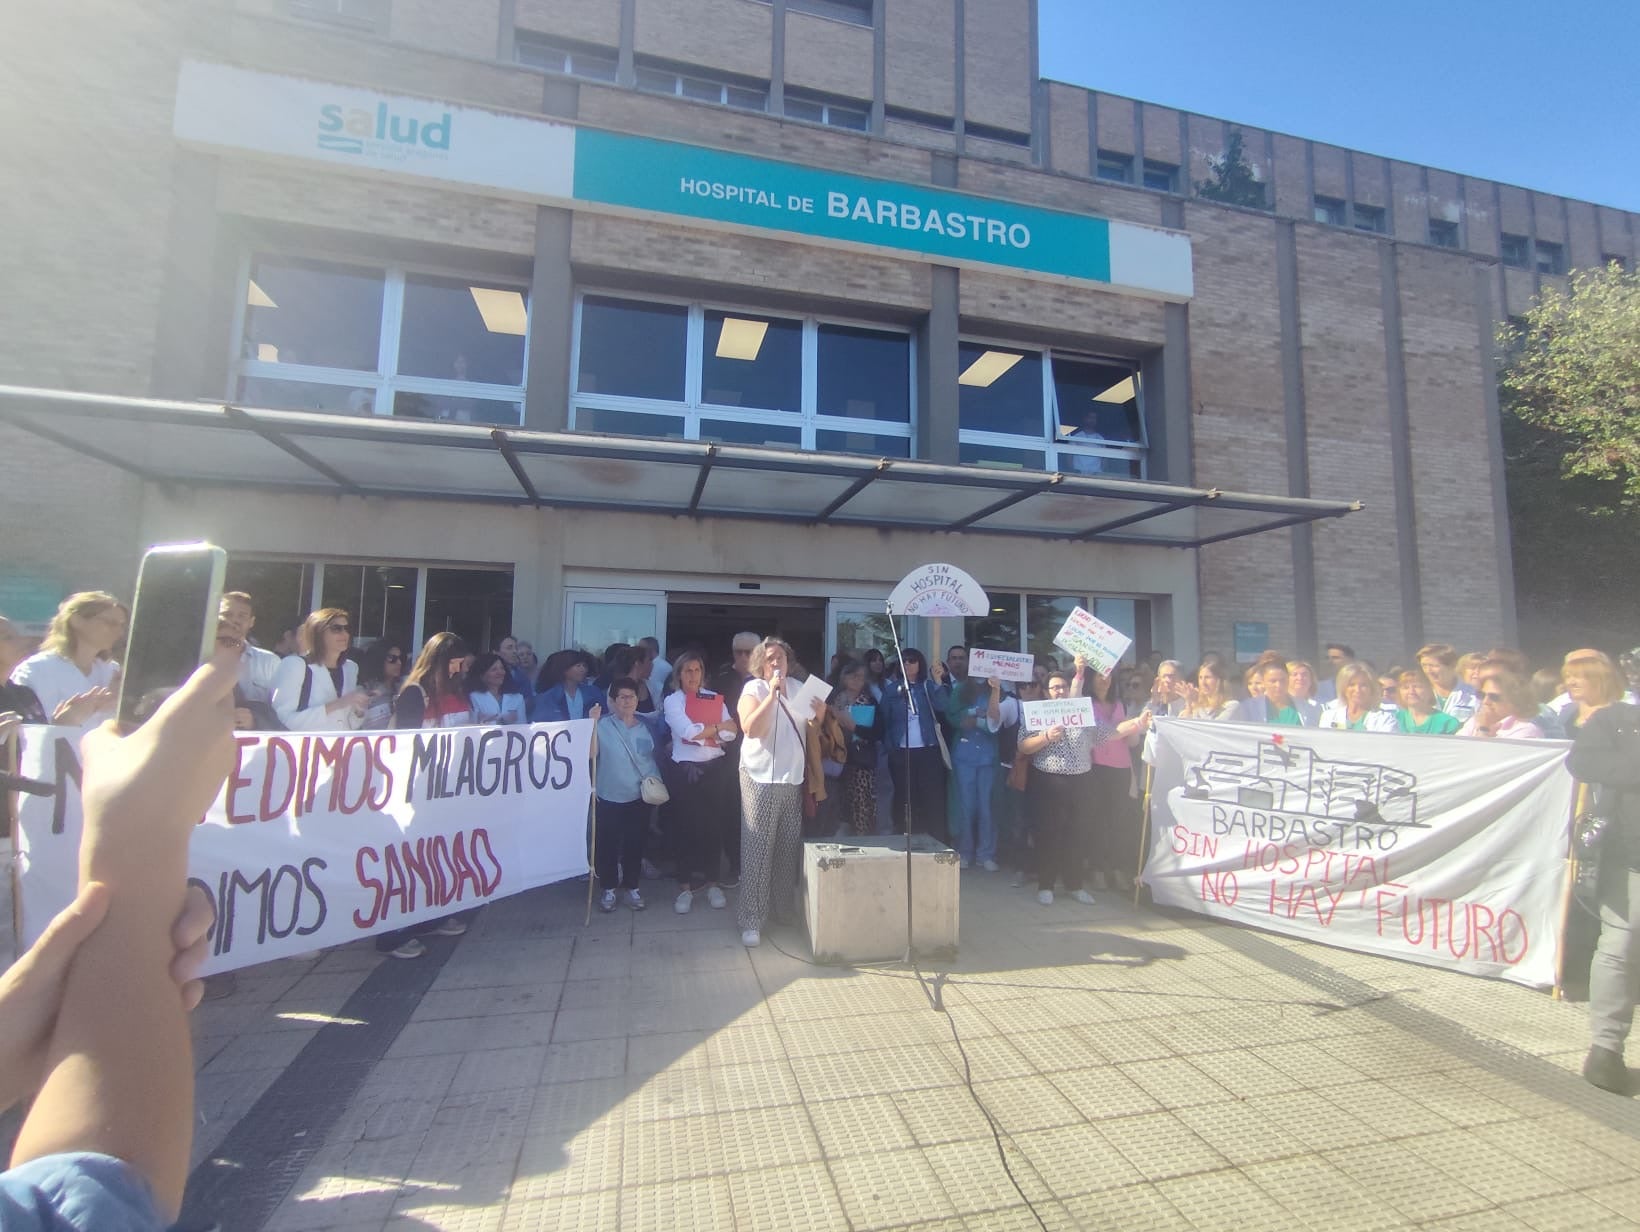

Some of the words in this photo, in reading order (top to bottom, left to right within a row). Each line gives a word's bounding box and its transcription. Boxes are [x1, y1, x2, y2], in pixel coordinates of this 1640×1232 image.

[319, 101, 452, 151] salud
[680, 177, 781, 209] HOSPITAL
[787, 194, 814, 213] DE
[827, 191, 1031, 249] BARBASTRO
[910, 574, 963, 594] HOSPITAL
[928, 565, 949, 574] SIN
[908, 602, 919, 614] NO
[920, 592, 937, 603] HAY
[941, 592, 969, 614] FUTURO
[1030, 717, 1043, 727] EN
[1045, 717, 1057, 727] LA
[1062, 713, 1084, 726] UCI
[198, 735, 396, 825] EDIMOS
[406, 729, 573, 803] MILAGROS
[1213, 805, 1398, 851] BARBASTRO
[353, 828, 502, 929] SANIDAD
[1172, 825, 1219, 859] SIN
[1243, 839, 1408, 888] HOSPITAL
[1201, 868, 1239, 907] NO
[1269, 880, 1344, 926] HAY
[1376, 890, 1529, 965] FUTURO
